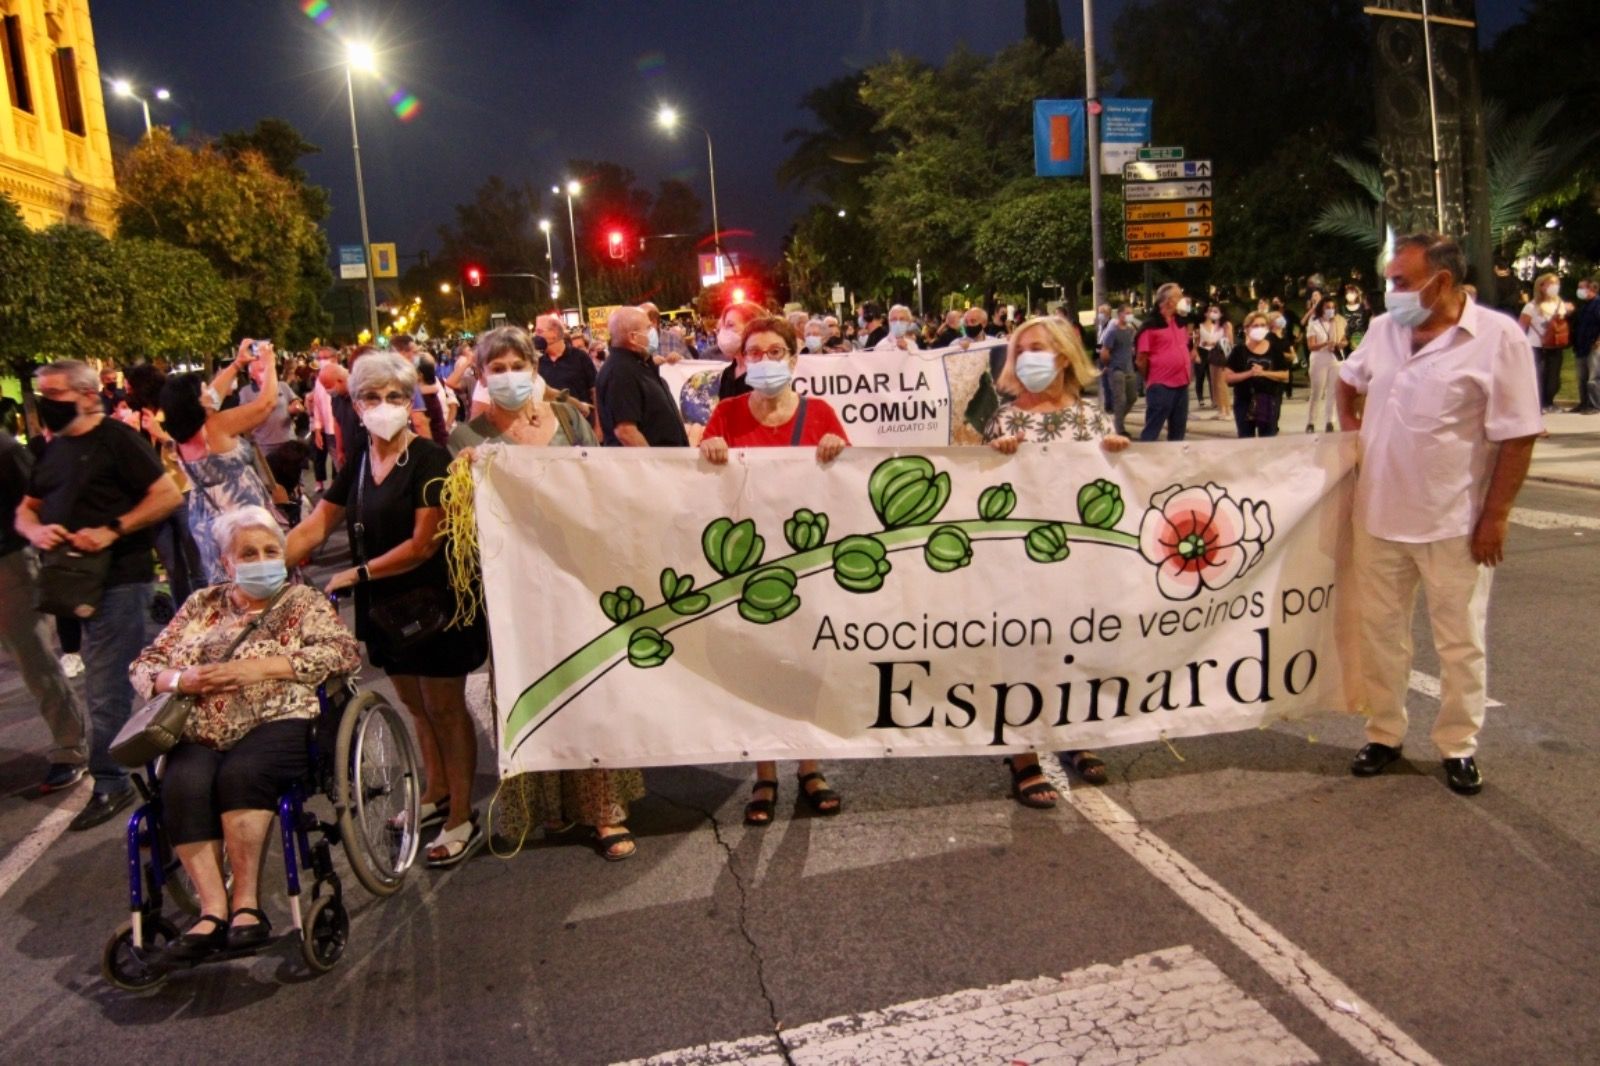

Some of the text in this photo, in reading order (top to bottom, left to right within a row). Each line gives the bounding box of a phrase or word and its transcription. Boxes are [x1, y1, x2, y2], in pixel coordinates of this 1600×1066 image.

[791, 371, 930, 397] CUIDAR LA
[878, 423, 925, 435] (LAUDATO
[812, 611, 1052, 651] Asociacion
[1069, 607, 1122, 644] de
[1138, 590, 1265, 638] vecinos
[866, 627, 1318, 746] Espinardo
